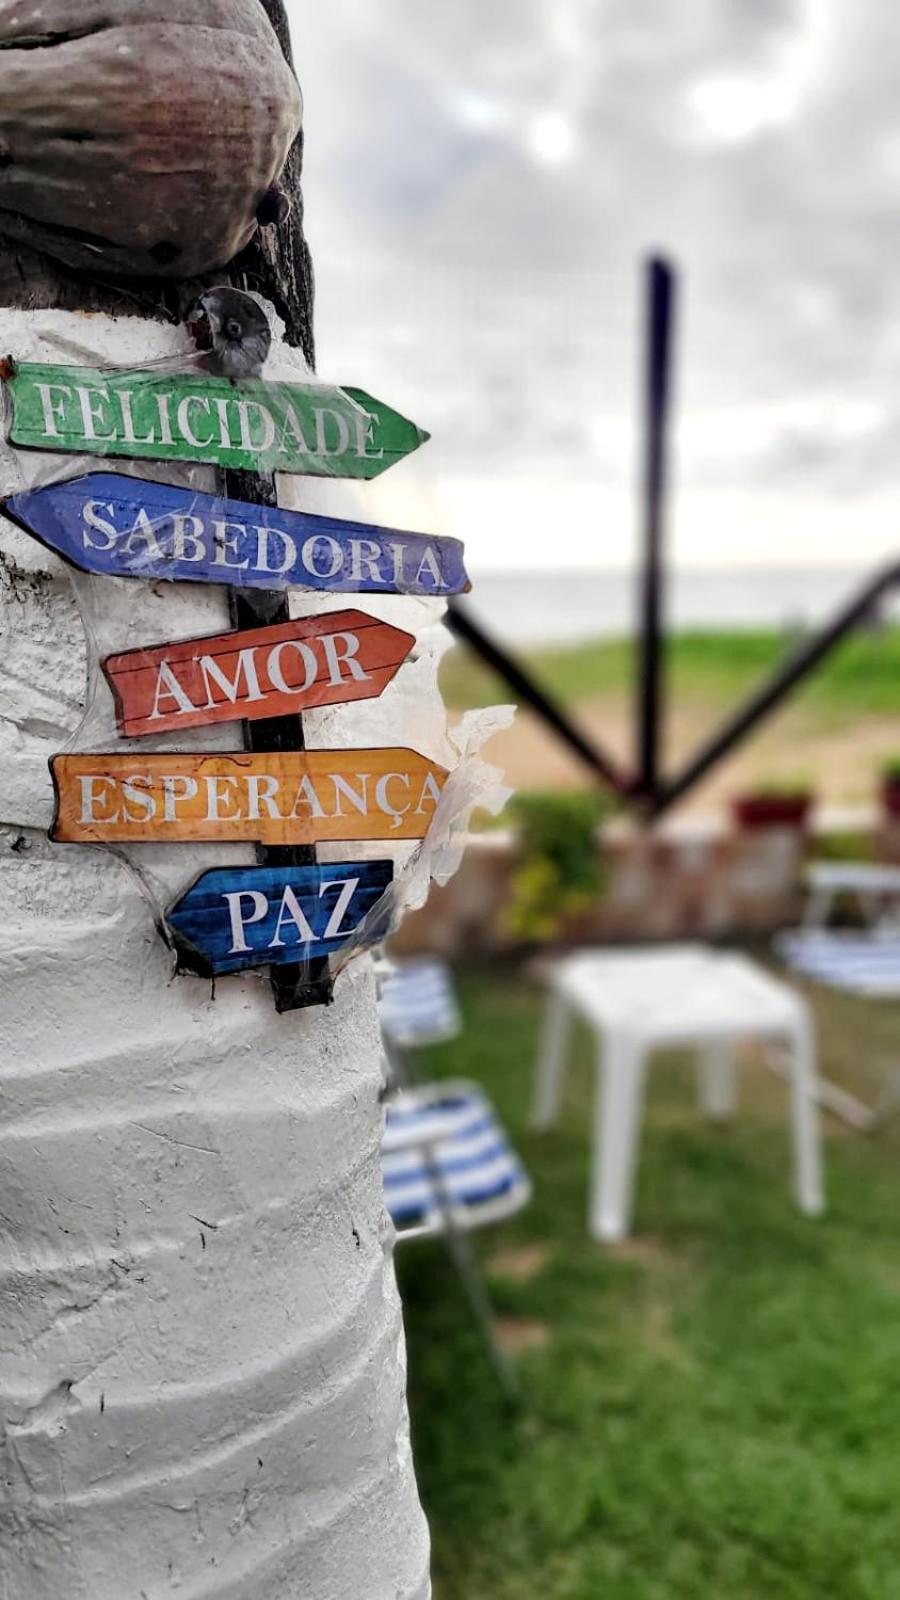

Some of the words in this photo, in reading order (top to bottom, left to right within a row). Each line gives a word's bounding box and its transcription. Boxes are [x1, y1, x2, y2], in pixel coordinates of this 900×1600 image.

[34, 383, 384, 459] FELICIDADE
[82, 501, 449, 588] SABEDORIA
[147, 631, 372, 720] AMOR
[75, 771, 442, 829] ESPERANÇA
[222, 877, 361, 954] PAZ
